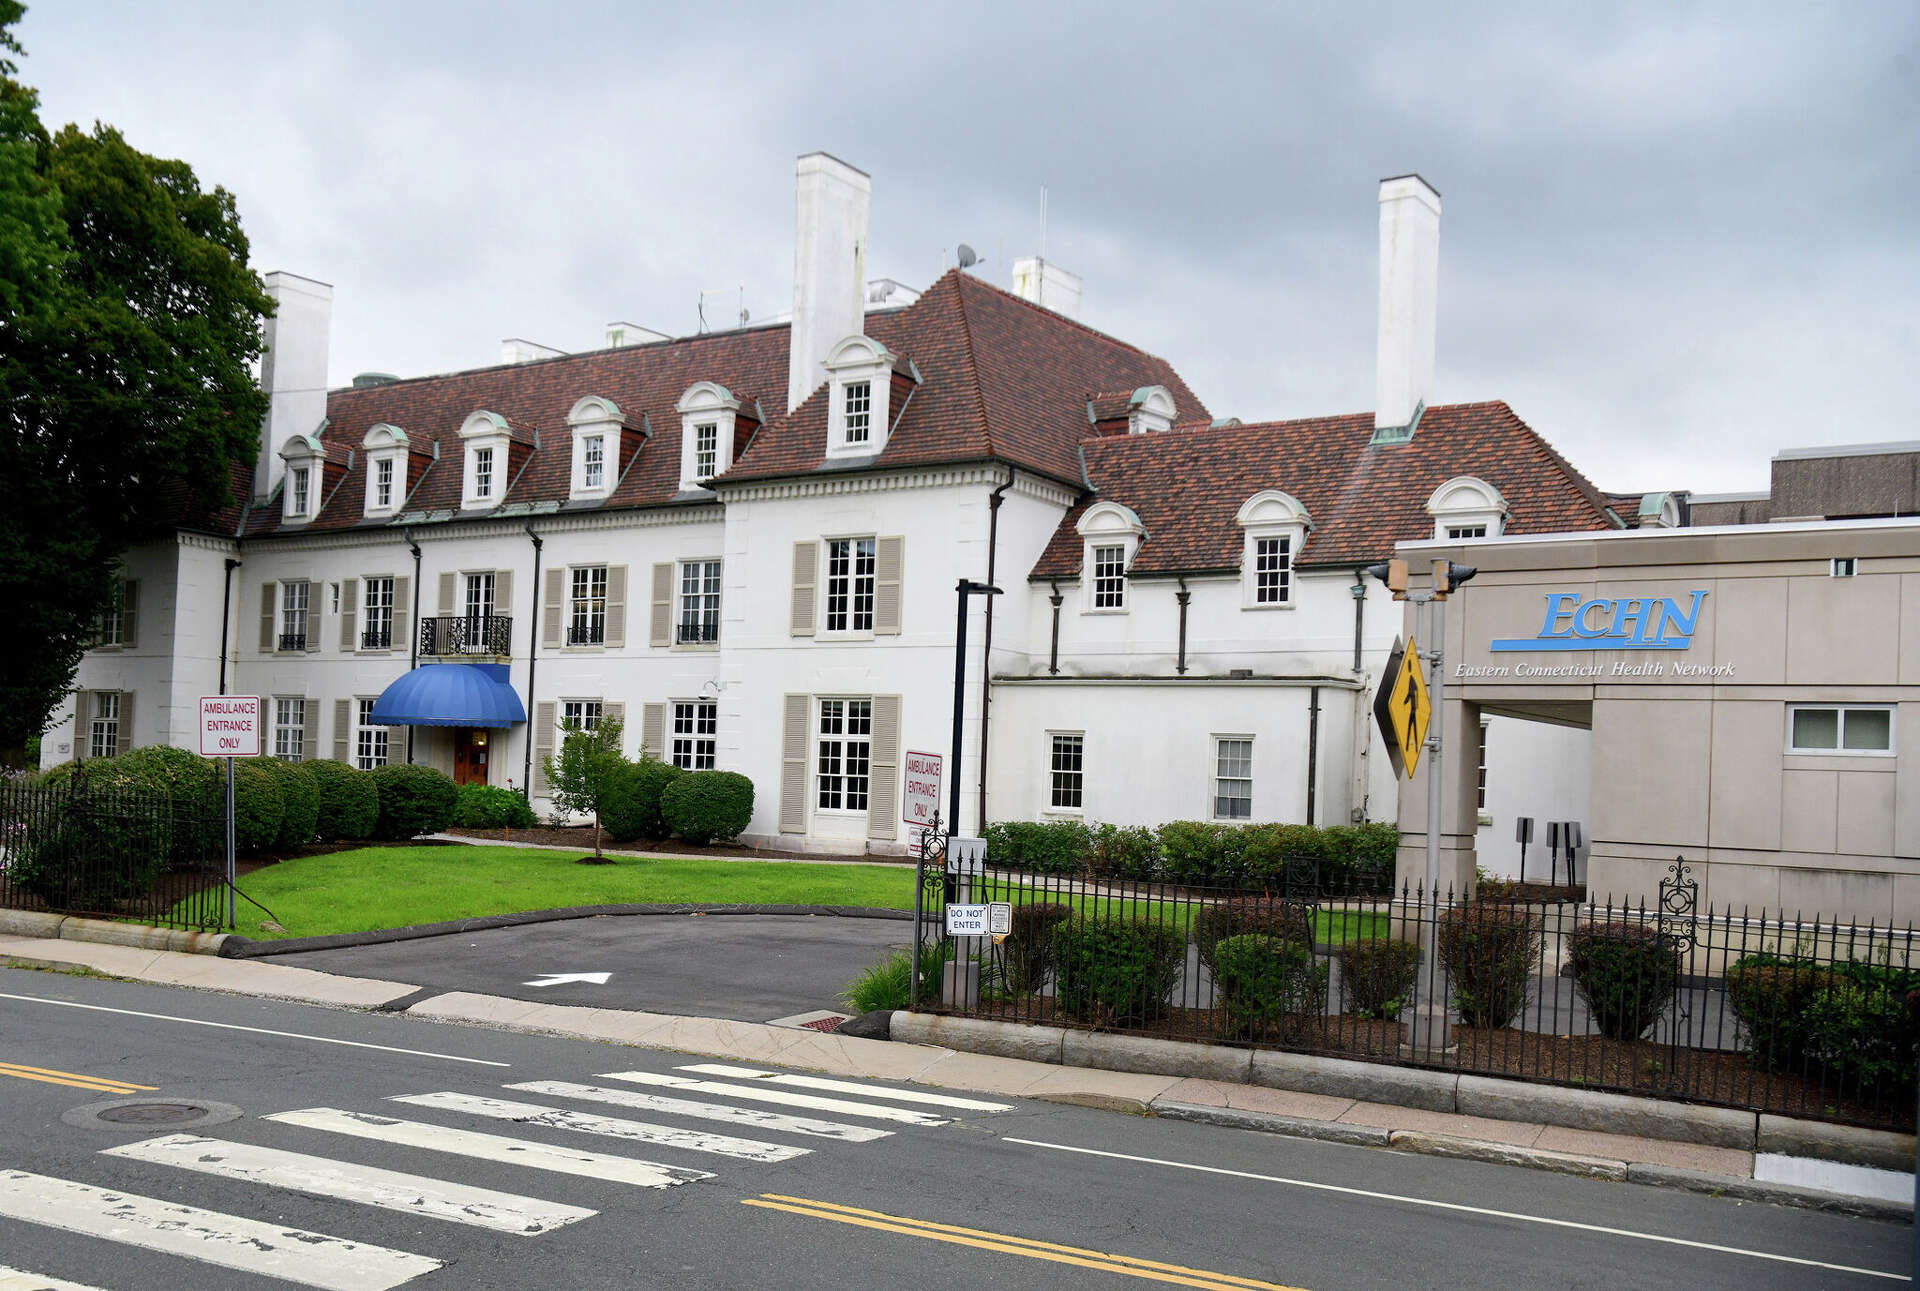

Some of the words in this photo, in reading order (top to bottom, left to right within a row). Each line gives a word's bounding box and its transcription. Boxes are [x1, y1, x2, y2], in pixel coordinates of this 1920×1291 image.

[1537, 590, 1709, 646] ECHN
[1455, 663, 1509, 678] Eastern
[1515, 663, 1603, 677] Connecticut
[1608, 661, 1664, 676] Health
[1671, 661, 1736, 676] Network
[204, 703, 256, 714] AMBULANCE
[207, 720, 252, 731] ENTRANCE
[218, 737, 240, 749] ONLY
[908, 760, 939, 776] AMBULANCE
[908, 781, 936, 798] ENTRANCE
[914, 803, 928, 817] ONLY
[950, 909, 963, 918] DO
[966, 909, 984, 918] NOT
[953, 921, 981, 929] ENTER
